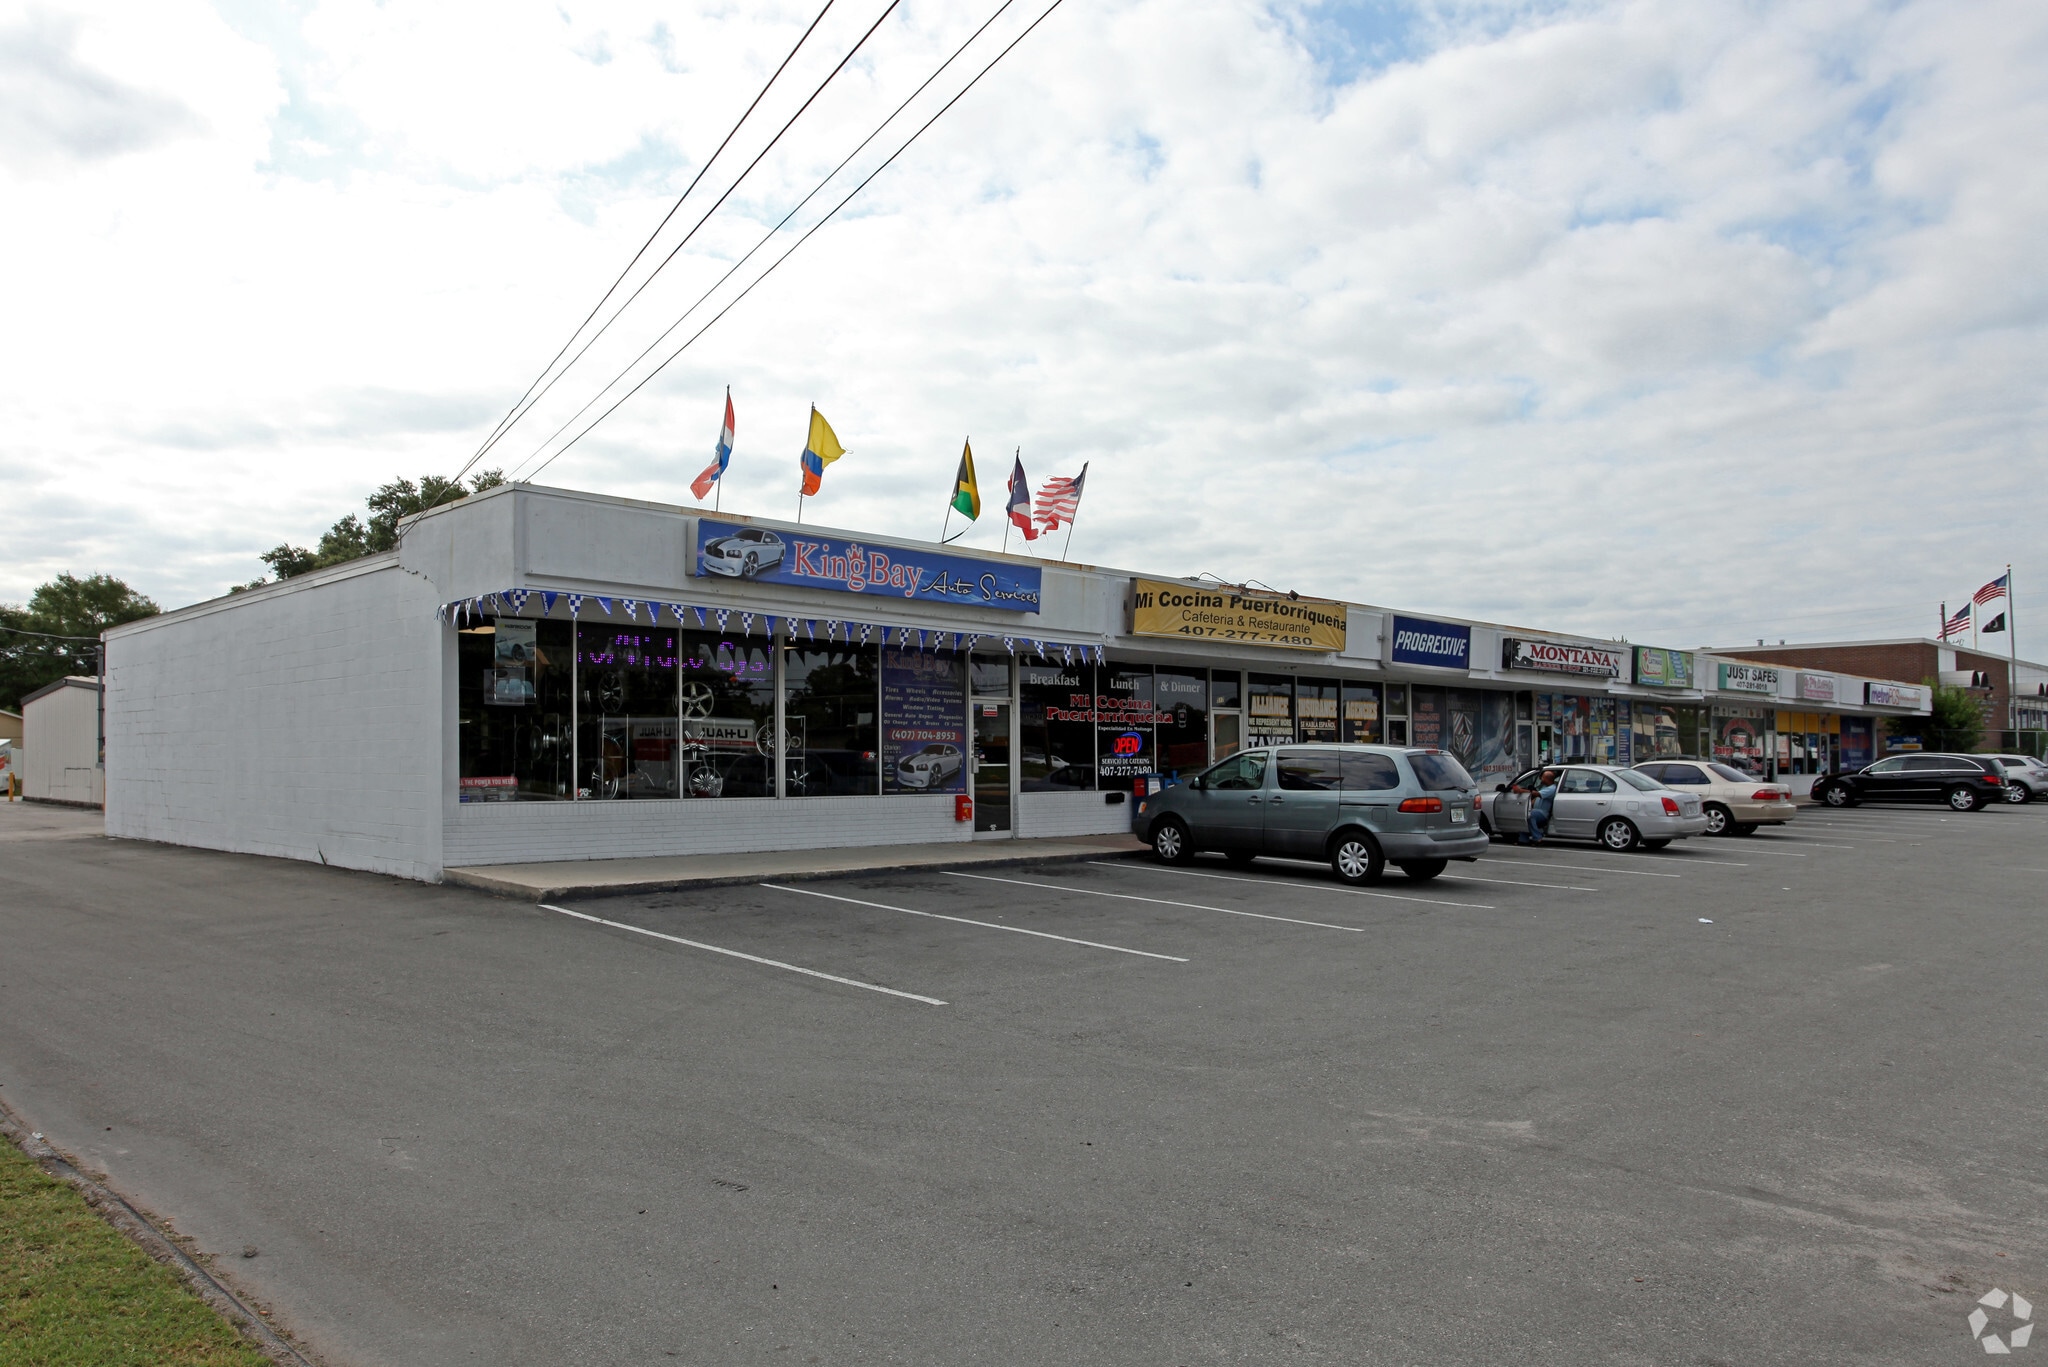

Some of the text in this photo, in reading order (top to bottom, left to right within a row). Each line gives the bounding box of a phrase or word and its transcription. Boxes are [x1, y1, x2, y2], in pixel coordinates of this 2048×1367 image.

[921, 571, 975, 595] Auto
[979, 573, 1039, 603] Services
[1135, 591, 1346, 632] Mi Cocina Puertorriqueña
[1181, 609, 1311, 634] Cafeteria & Restaurante
[1178, 625, 1313, 646] 407-277-7480
[1395, 630, 1467, 657] PROGRESSIVE
[1530, 644, 1612, 667] MONTANA
[1029, 673, 1080, 687] Breakfast
[1727, 665, 1777, 683] JUST SAFES
[1110, 678, 1140, 690] Lunch
[1160, 681, 1201, 693] & Dinner
[1069, 694, 1153, 710] Mi Cocina
[1046, 706, 1174, 725] Puertorriqueña
[891, 730, 956, 741] (407) 704-8953
[1114, 737, 1139, 753] OPEN
[1100, 766, 1152, 777] 407-277-7480
